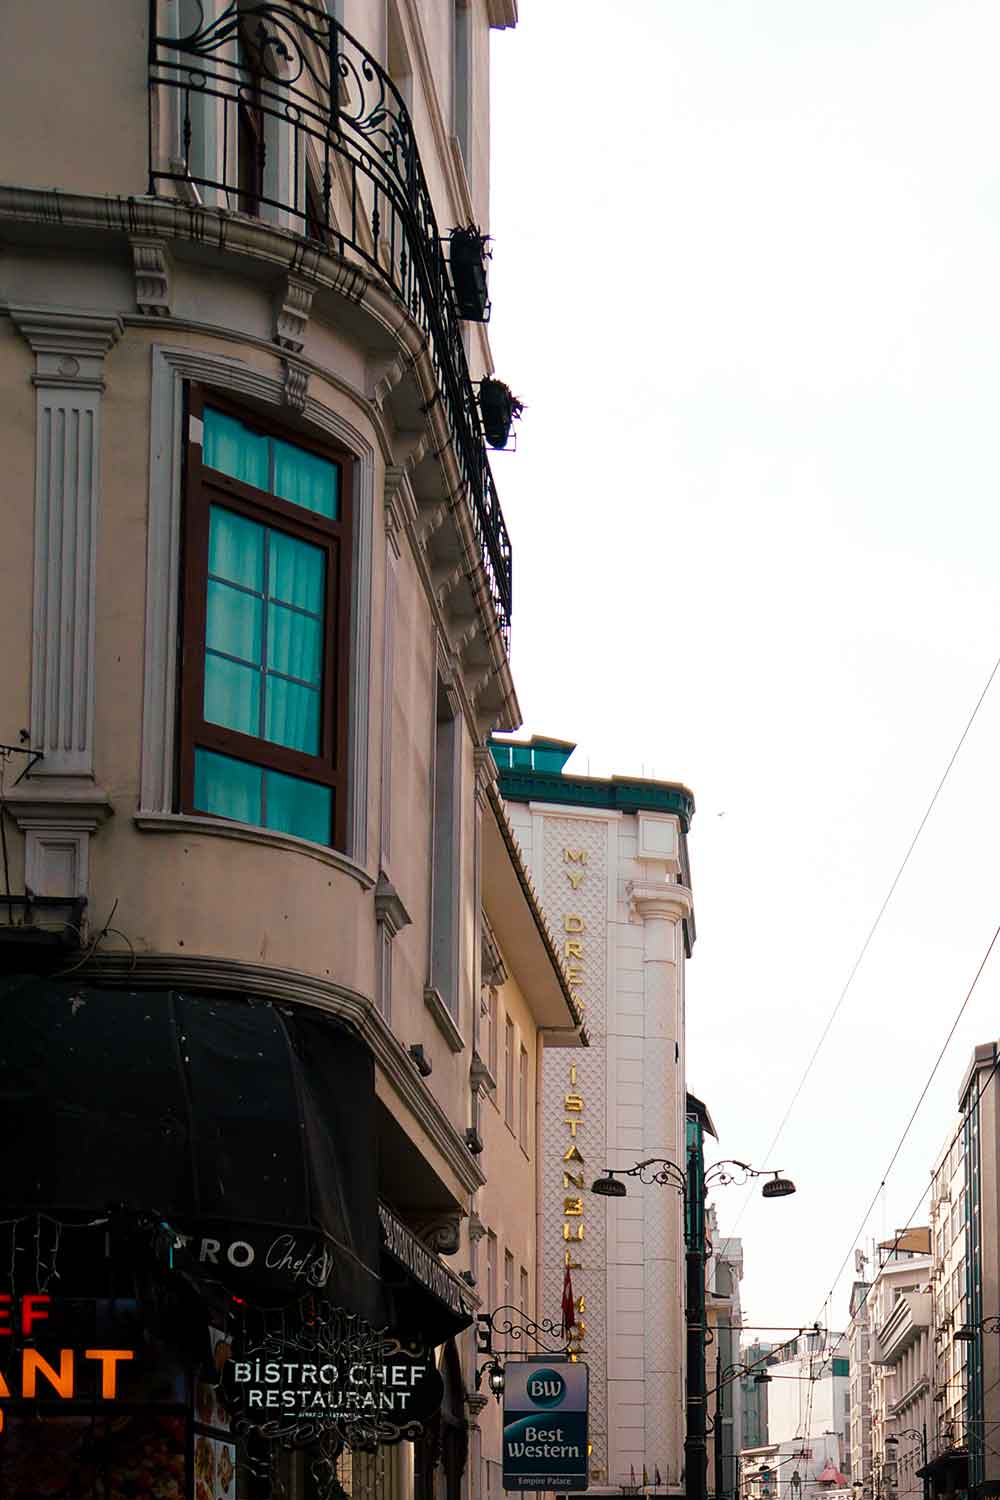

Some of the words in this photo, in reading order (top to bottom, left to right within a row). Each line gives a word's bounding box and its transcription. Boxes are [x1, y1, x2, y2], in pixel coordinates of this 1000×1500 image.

[563, 847, 589, 890] MY
[348, 1364, 427, 1387] CHEF
[531, 1380, 562, 1398] BW
[248, 1389, 412, 1410] RESTAURANT
[525, 1427, 564, 1443] Best
[507, 1443, 580, 1458] Western
[518, 1477, 546, 1487] Empire
[547, 1477, 573, 1486] Palace
